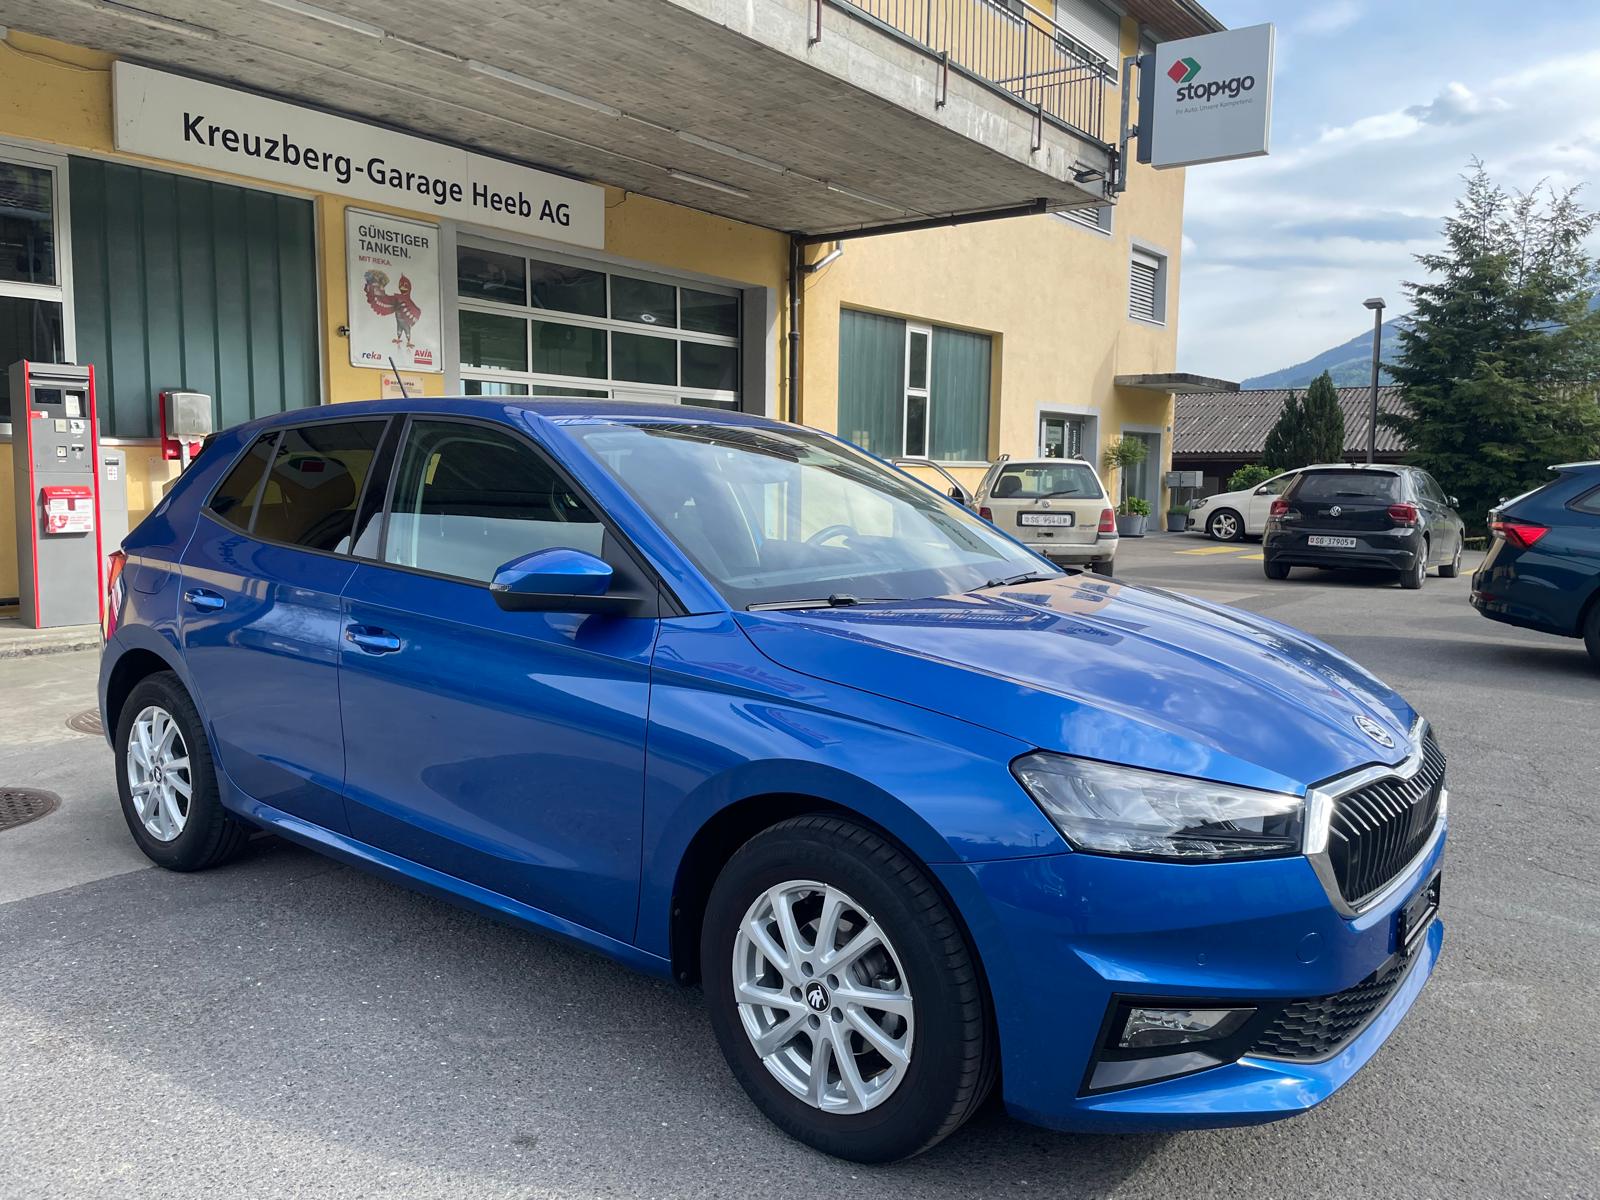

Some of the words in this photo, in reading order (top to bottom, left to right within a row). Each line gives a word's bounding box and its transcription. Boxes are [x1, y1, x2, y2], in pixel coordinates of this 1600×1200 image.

[1176, 76, 1255, 102] stop+go
[183, 112, 463, 205] Kreuzberg-Garage
[472, 182, 532, 218] Heeb
[539, 199, 571, 227] AG
[358, 224, 429, 248] GÜNSTIGER
[358, 239, 412, 259] TANKEN.
[358, 255, 371, 263] MIT
[372, 256, 393, 266] REKA.
[361, 351, 382, 361] reka
[414, 349, 433, 358] AVIA
